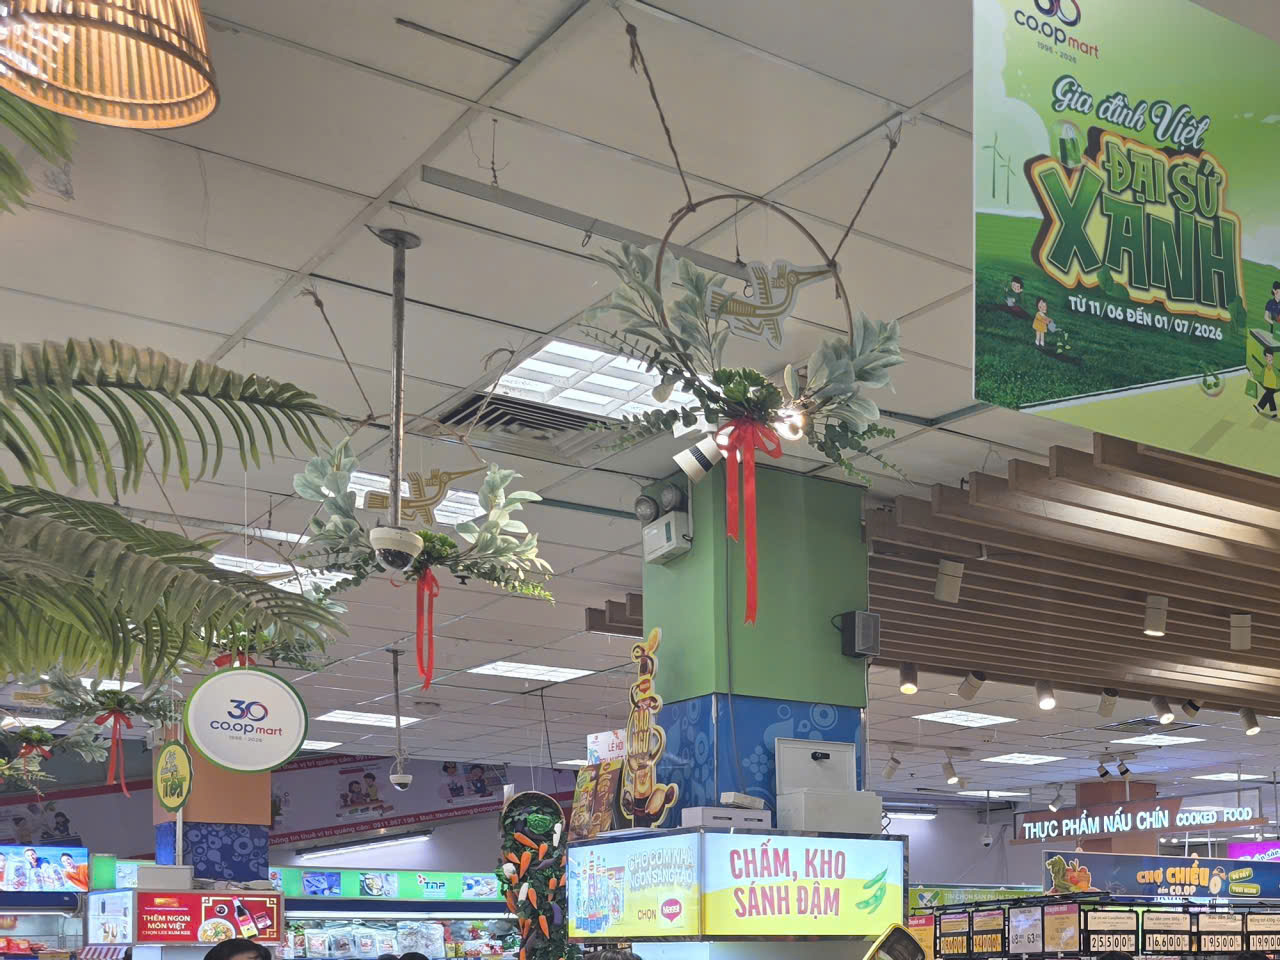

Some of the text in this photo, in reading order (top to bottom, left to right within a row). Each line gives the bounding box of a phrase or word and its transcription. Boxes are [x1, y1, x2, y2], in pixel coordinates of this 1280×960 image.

[1054, 77, 1210, 150] Gia đình Việt
[1105, 138, 1221, 217] ĐẠI SỨ
[1040, 164, 1238, 310] XANH
[1068, 295, 1223, 340] TỪ 11/06 ĐẾN 01/07/2026
[227, 699, 269, 722] 30
[1023, 806, 1253, 842] THỰC PHẨM NẤU CHÍN COOKED FOOD
[729, 838, 846, 883] CHẤM, KHO
[1136, 859, 1210, 887] CHỢ CHIỀU
[734, 880, 840, 920] SÁNH ĐẬM
[1169, 885, 1197, 896] CO.OP
[142, 914, 166, 922] THÊM
[148, 922, 186, 930] MÓN VIỆT
[638, 908, 657, 922] CHỌN
[1147, 936, 1181, 948] 16.600
